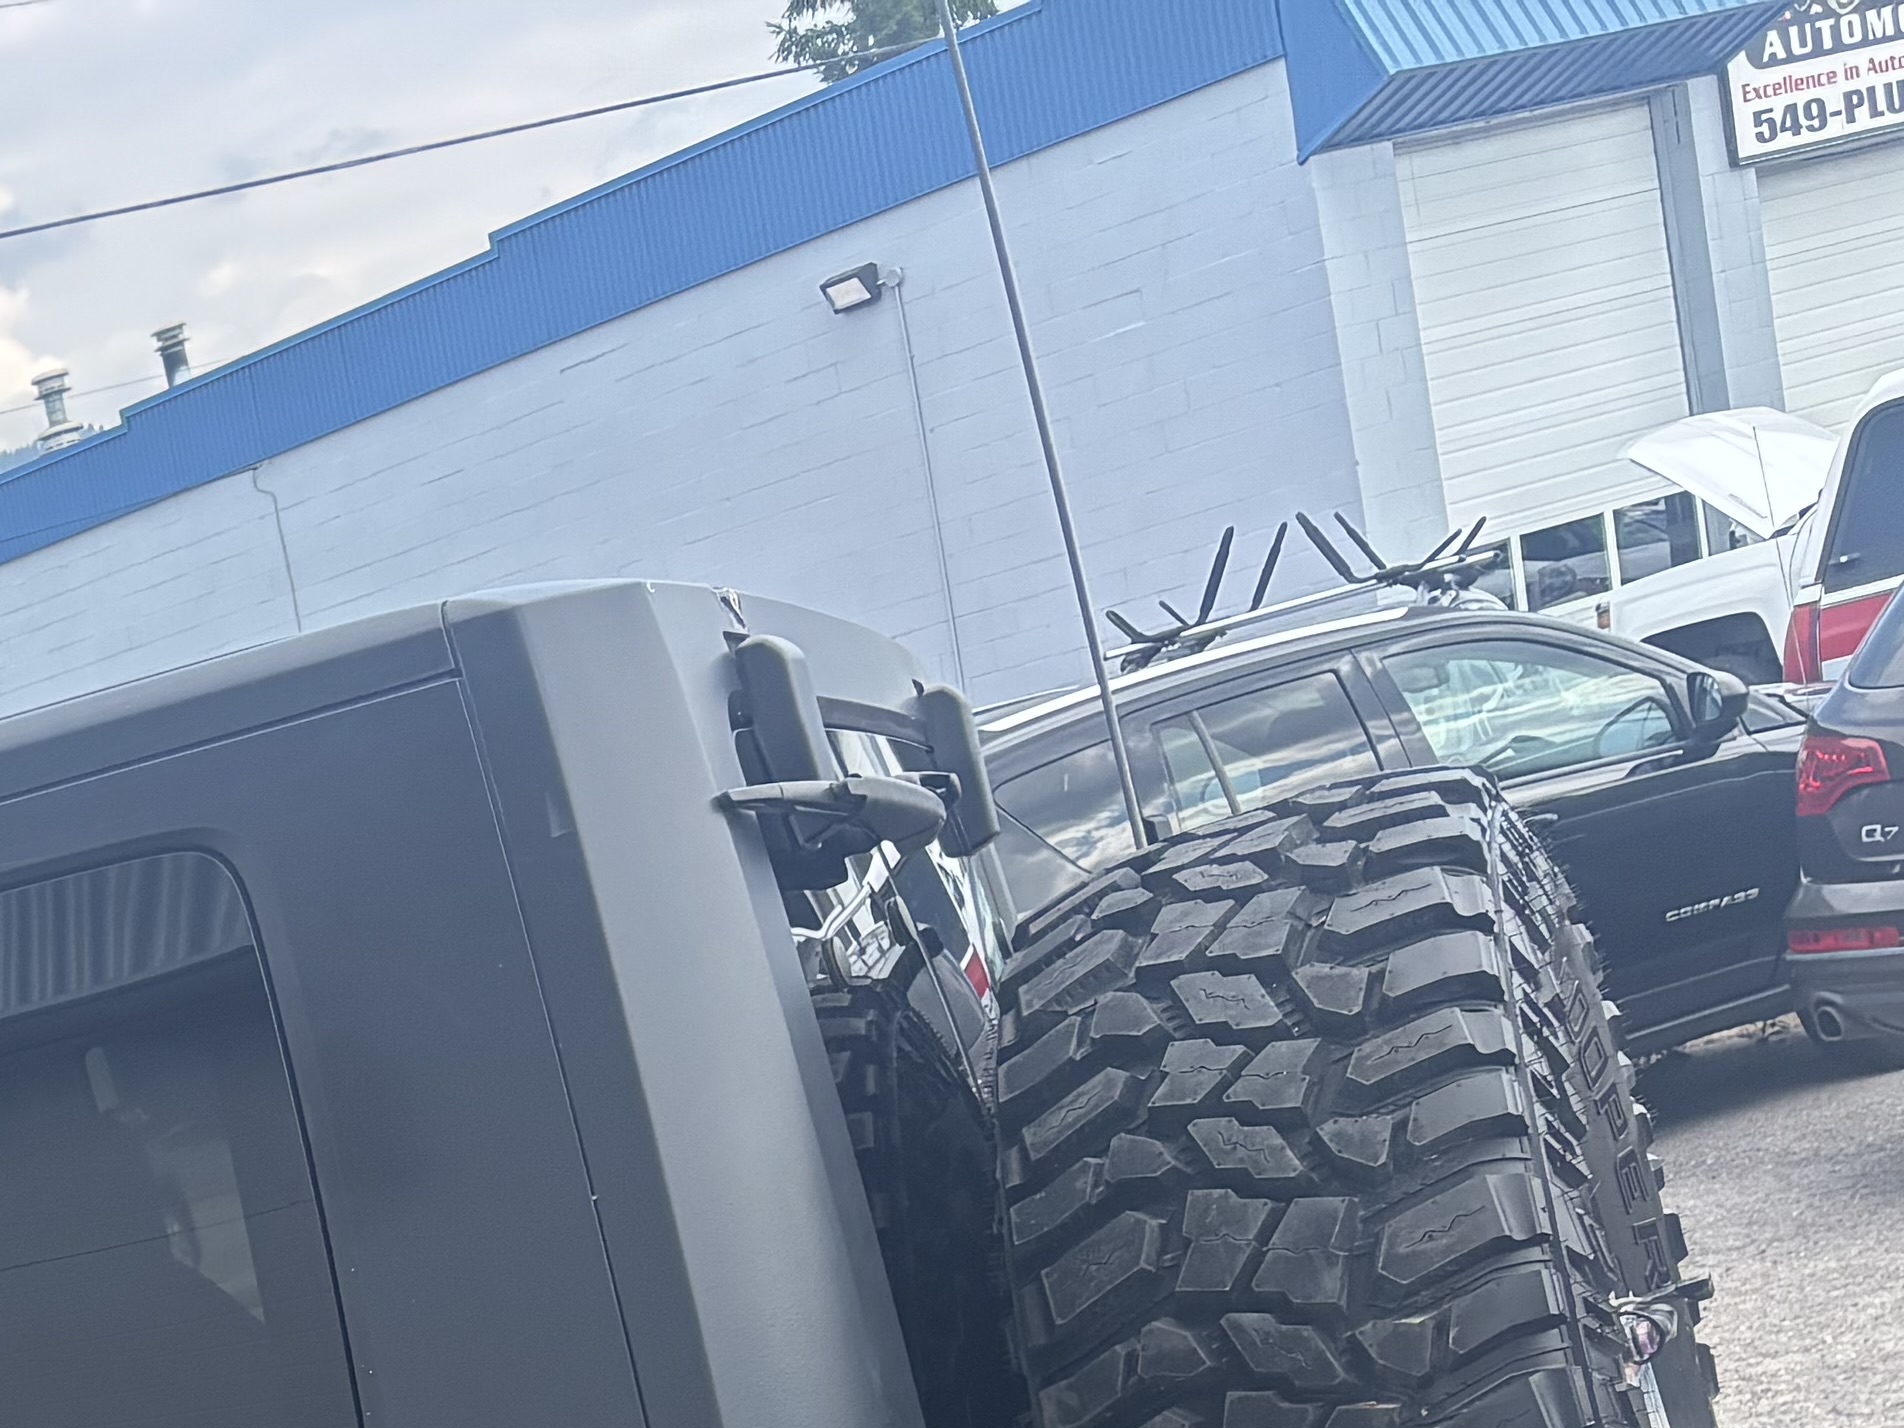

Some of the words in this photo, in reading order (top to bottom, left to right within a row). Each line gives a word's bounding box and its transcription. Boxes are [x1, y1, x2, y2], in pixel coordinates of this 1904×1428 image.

[1741, 70, 1838, 103] Excellence
[1844, 62, 1860, 81] in
[1861, 824, 1900, 842] Q7
